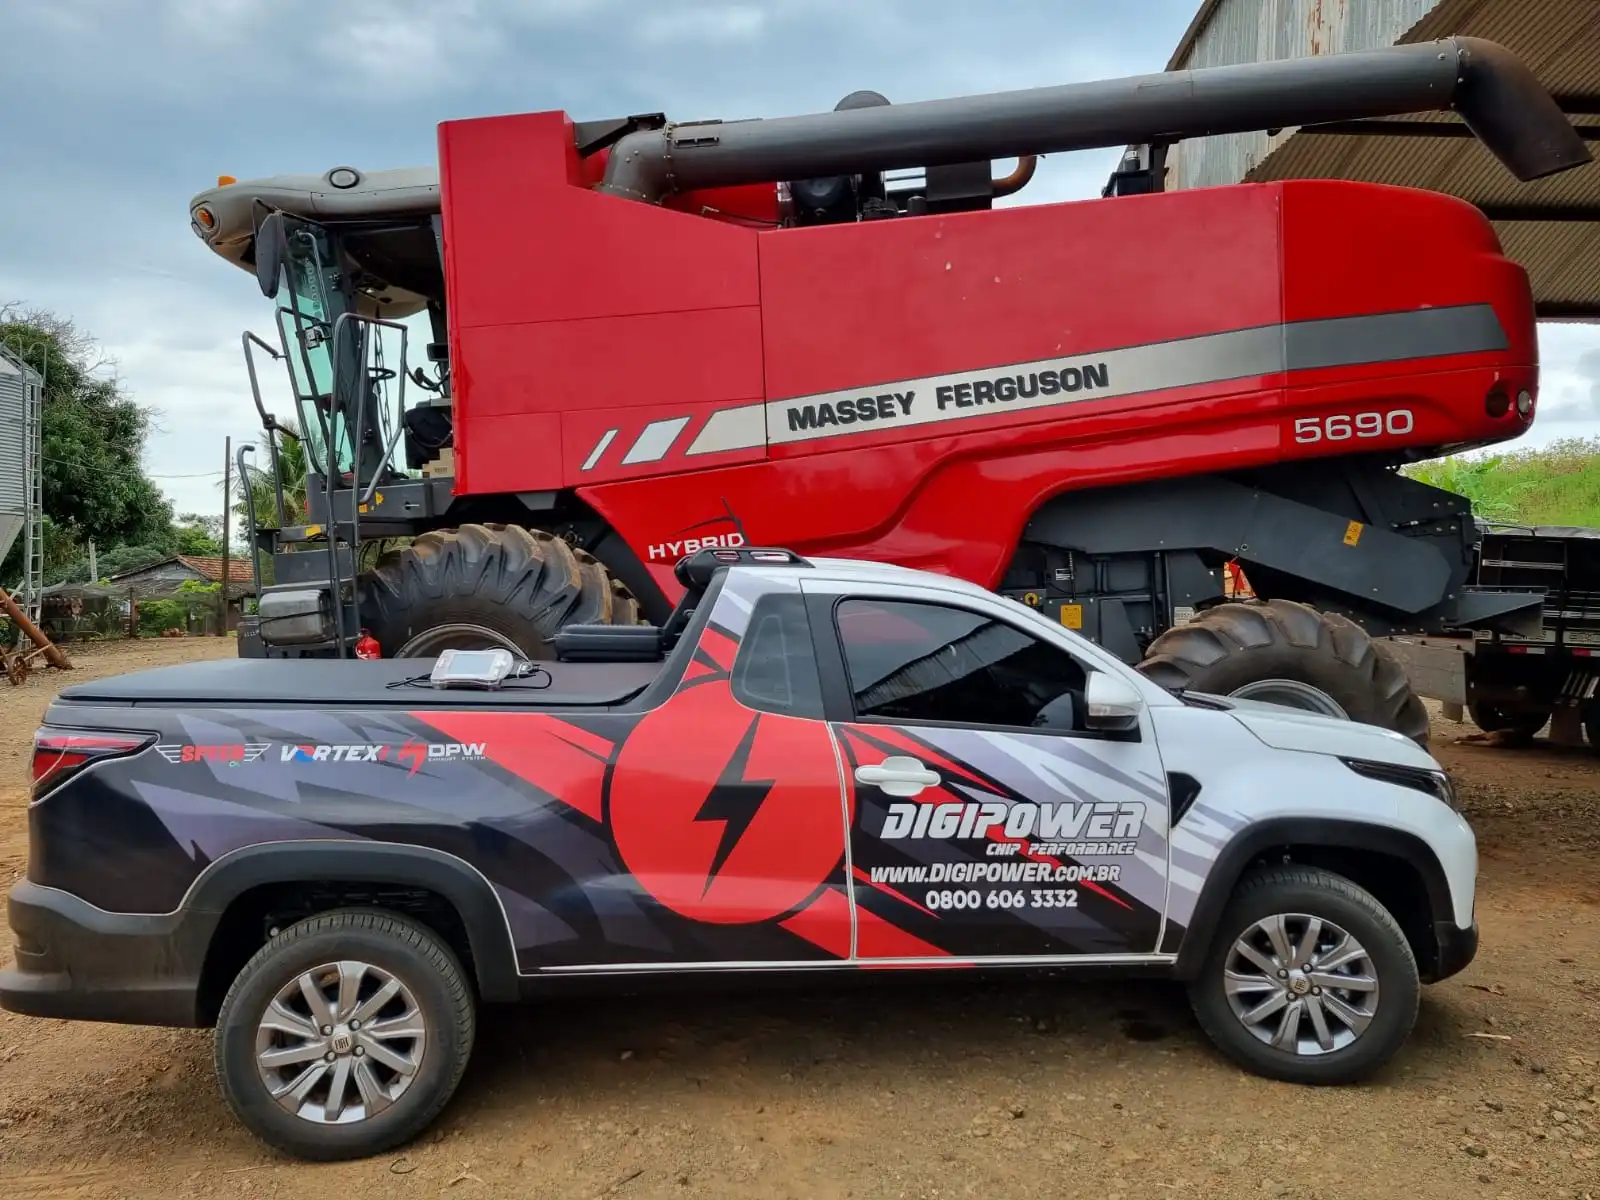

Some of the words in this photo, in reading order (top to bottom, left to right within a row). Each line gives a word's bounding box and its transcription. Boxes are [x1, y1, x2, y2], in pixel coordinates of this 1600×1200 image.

[787, 390, 916, 431] MASSEY
[935, 362, 1109, 410] FERGUSON
[1294, 409, 1414, 443] 5690
[648, 532, 745, 560] HYBRID
[280, 744, 384, 762] VORTEX
[428, 743, 487, 757] DPW
[880, 802, 1146, 839] DIGIPOWER
[986, 842, 1022, 856] CHIP
[1028, 842, 1136, 856] PERFORMANCE
[870, 862, 1121, 883] WWW.DIGIPOWER.COM.BR
[925, 890, 981, 910] 0800
[986, 890, 1025, 909] 606
[1030, 889, 1078, 908] 3332
